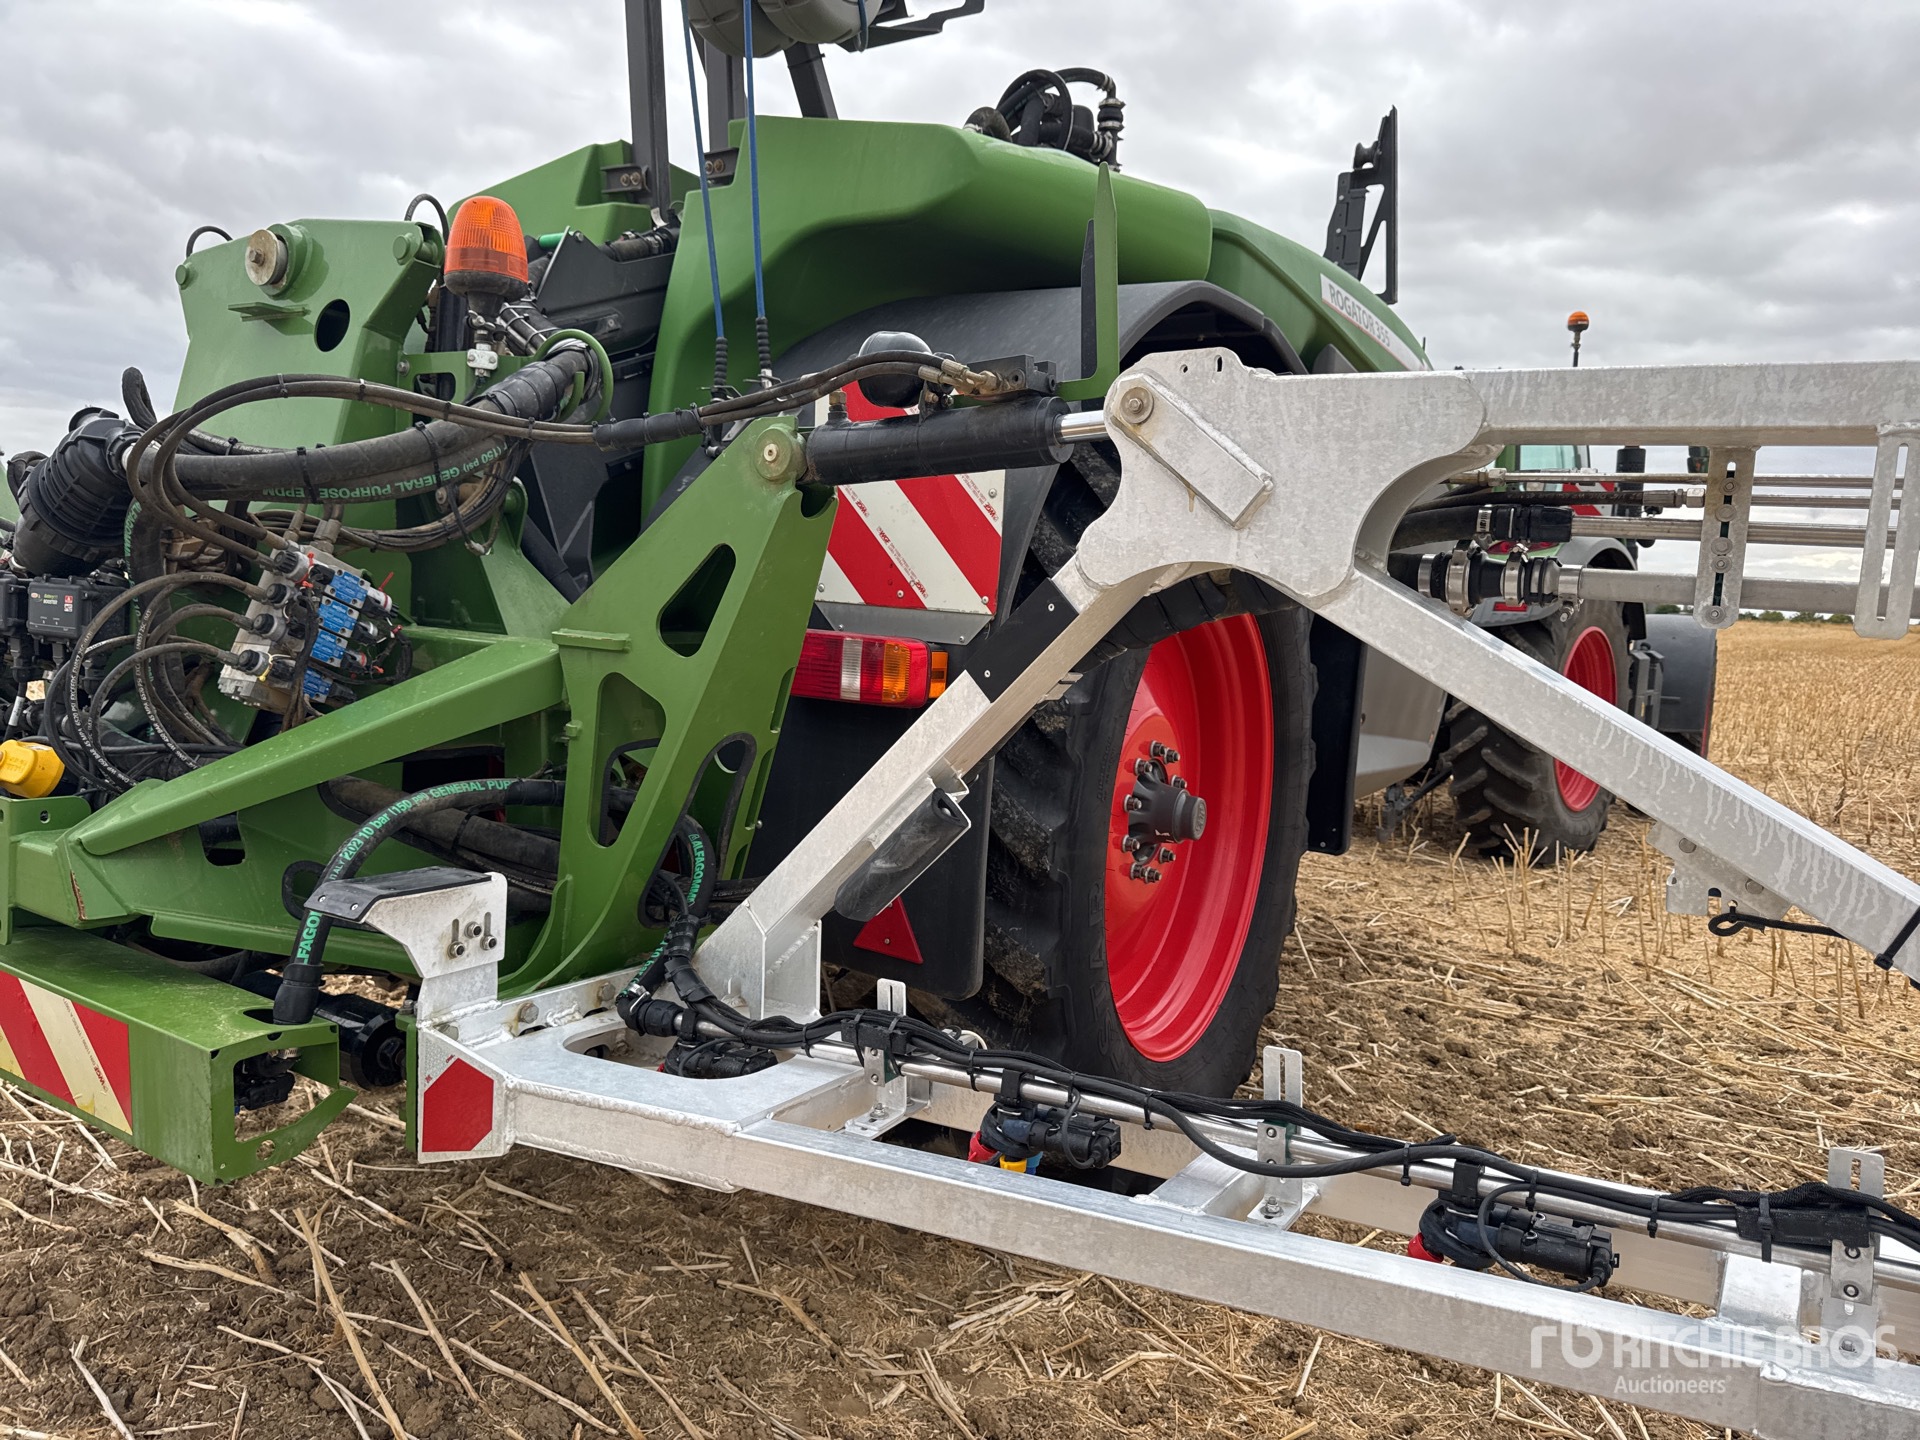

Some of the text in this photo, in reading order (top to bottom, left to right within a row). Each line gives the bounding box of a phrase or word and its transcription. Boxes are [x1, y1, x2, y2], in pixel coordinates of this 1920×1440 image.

[1328, 283, 1391, 347] ROGATOR 355
[262, 487, 305, 498] EPDM
[319, 484, 391, 498] PURPOSE
[90, 748, 100, 760] BAR
[359, 826, 375, 841] 10
[370, 812, 391, 830] bar
[429, 781, 486, 799] GENERAL
